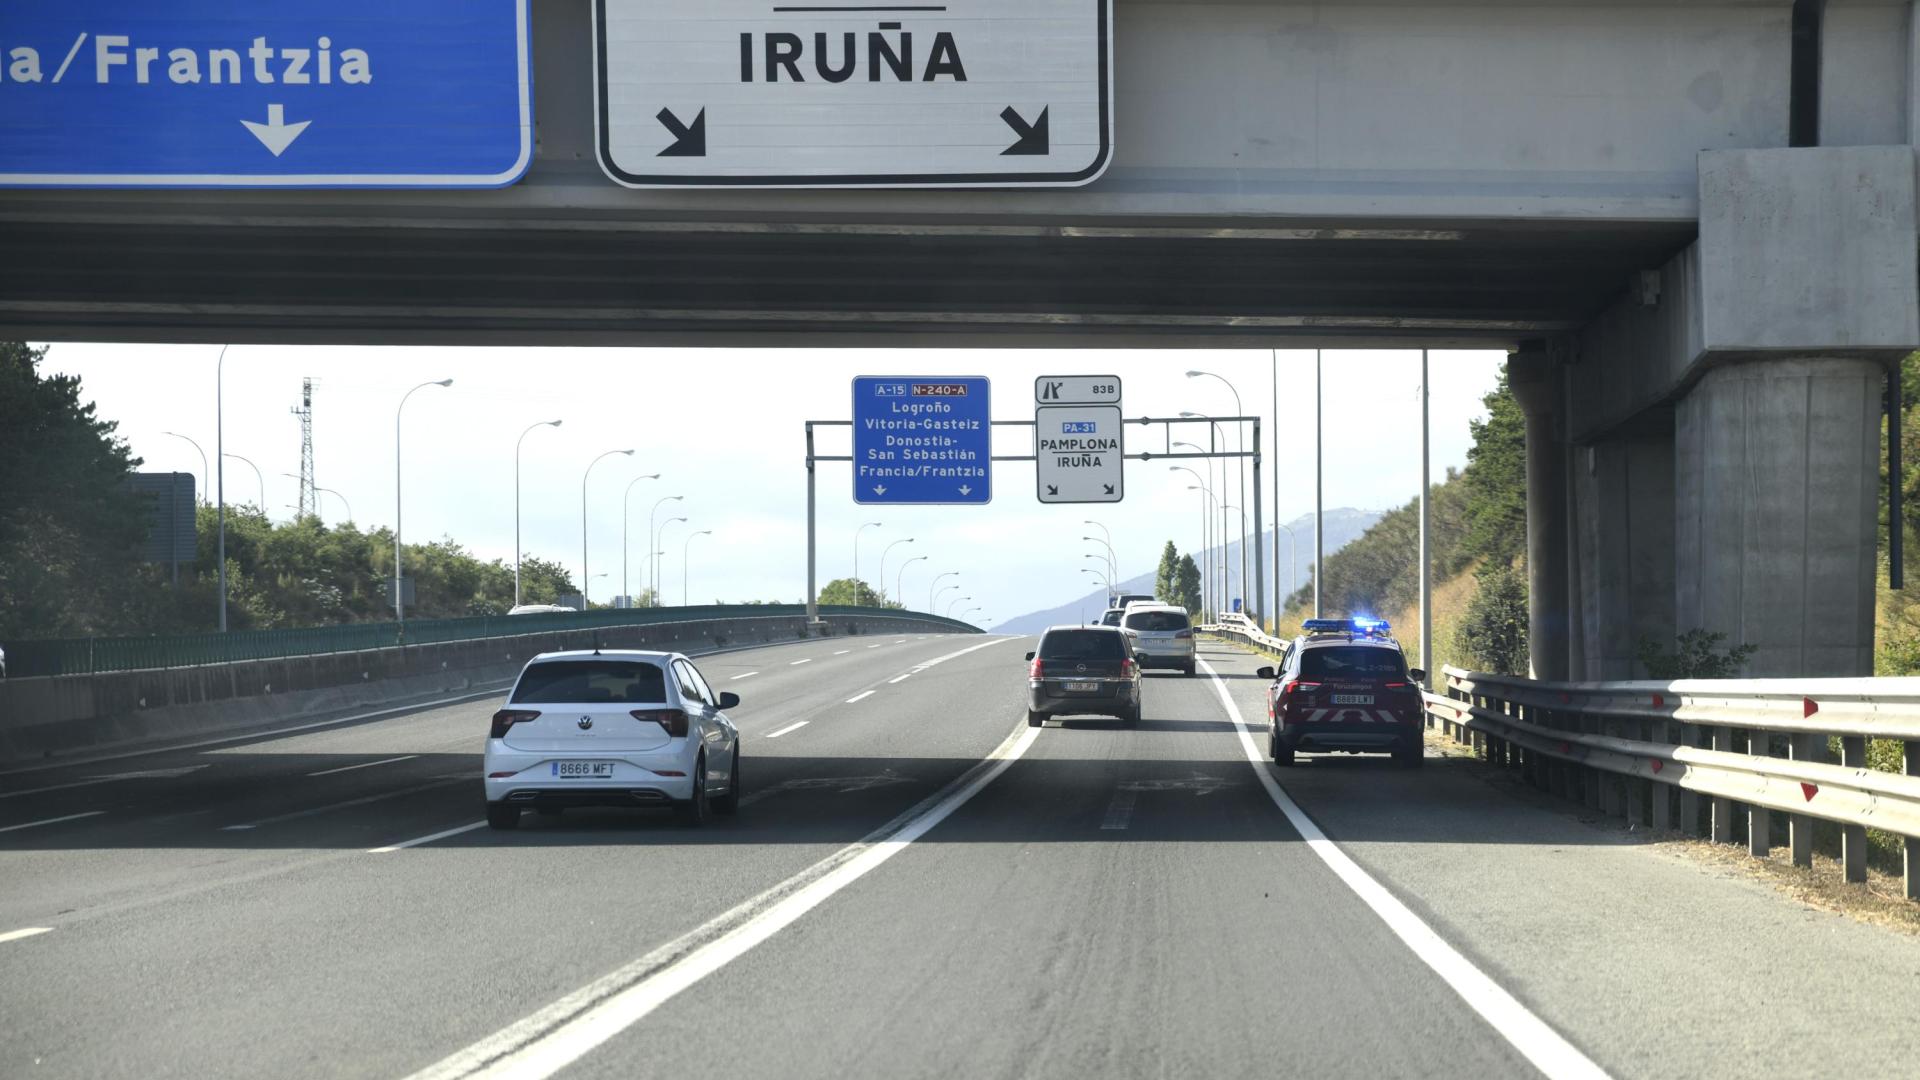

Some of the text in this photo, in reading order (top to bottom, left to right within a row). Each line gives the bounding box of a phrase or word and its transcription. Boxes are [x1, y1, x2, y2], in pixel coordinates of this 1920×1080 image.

[0, 33, 373, 84] a/Frantzia
[740, 22, 968, 84] IRUÑA
[877, 386, 966, 395] A-15 N-240-A
[1092, 385, 1115, 394] 83B
[892, 402, 951, 416] Logroño
[865, 418, 980, 430] Vitoria-Gasteiz
[1064, 423, 1095, 433] PA-31
[886, 435, 958, 446] Donostia-
[1041, 439, 1118, 450] PAMPLONA
[868, 448, 976, 460] San Sebastián
[1057, 454, 1102, 467] IRUÑA
[860, 465, 985, 477] Francia/Frantzia
[560, 763, 616, 774] 8666 MFT
